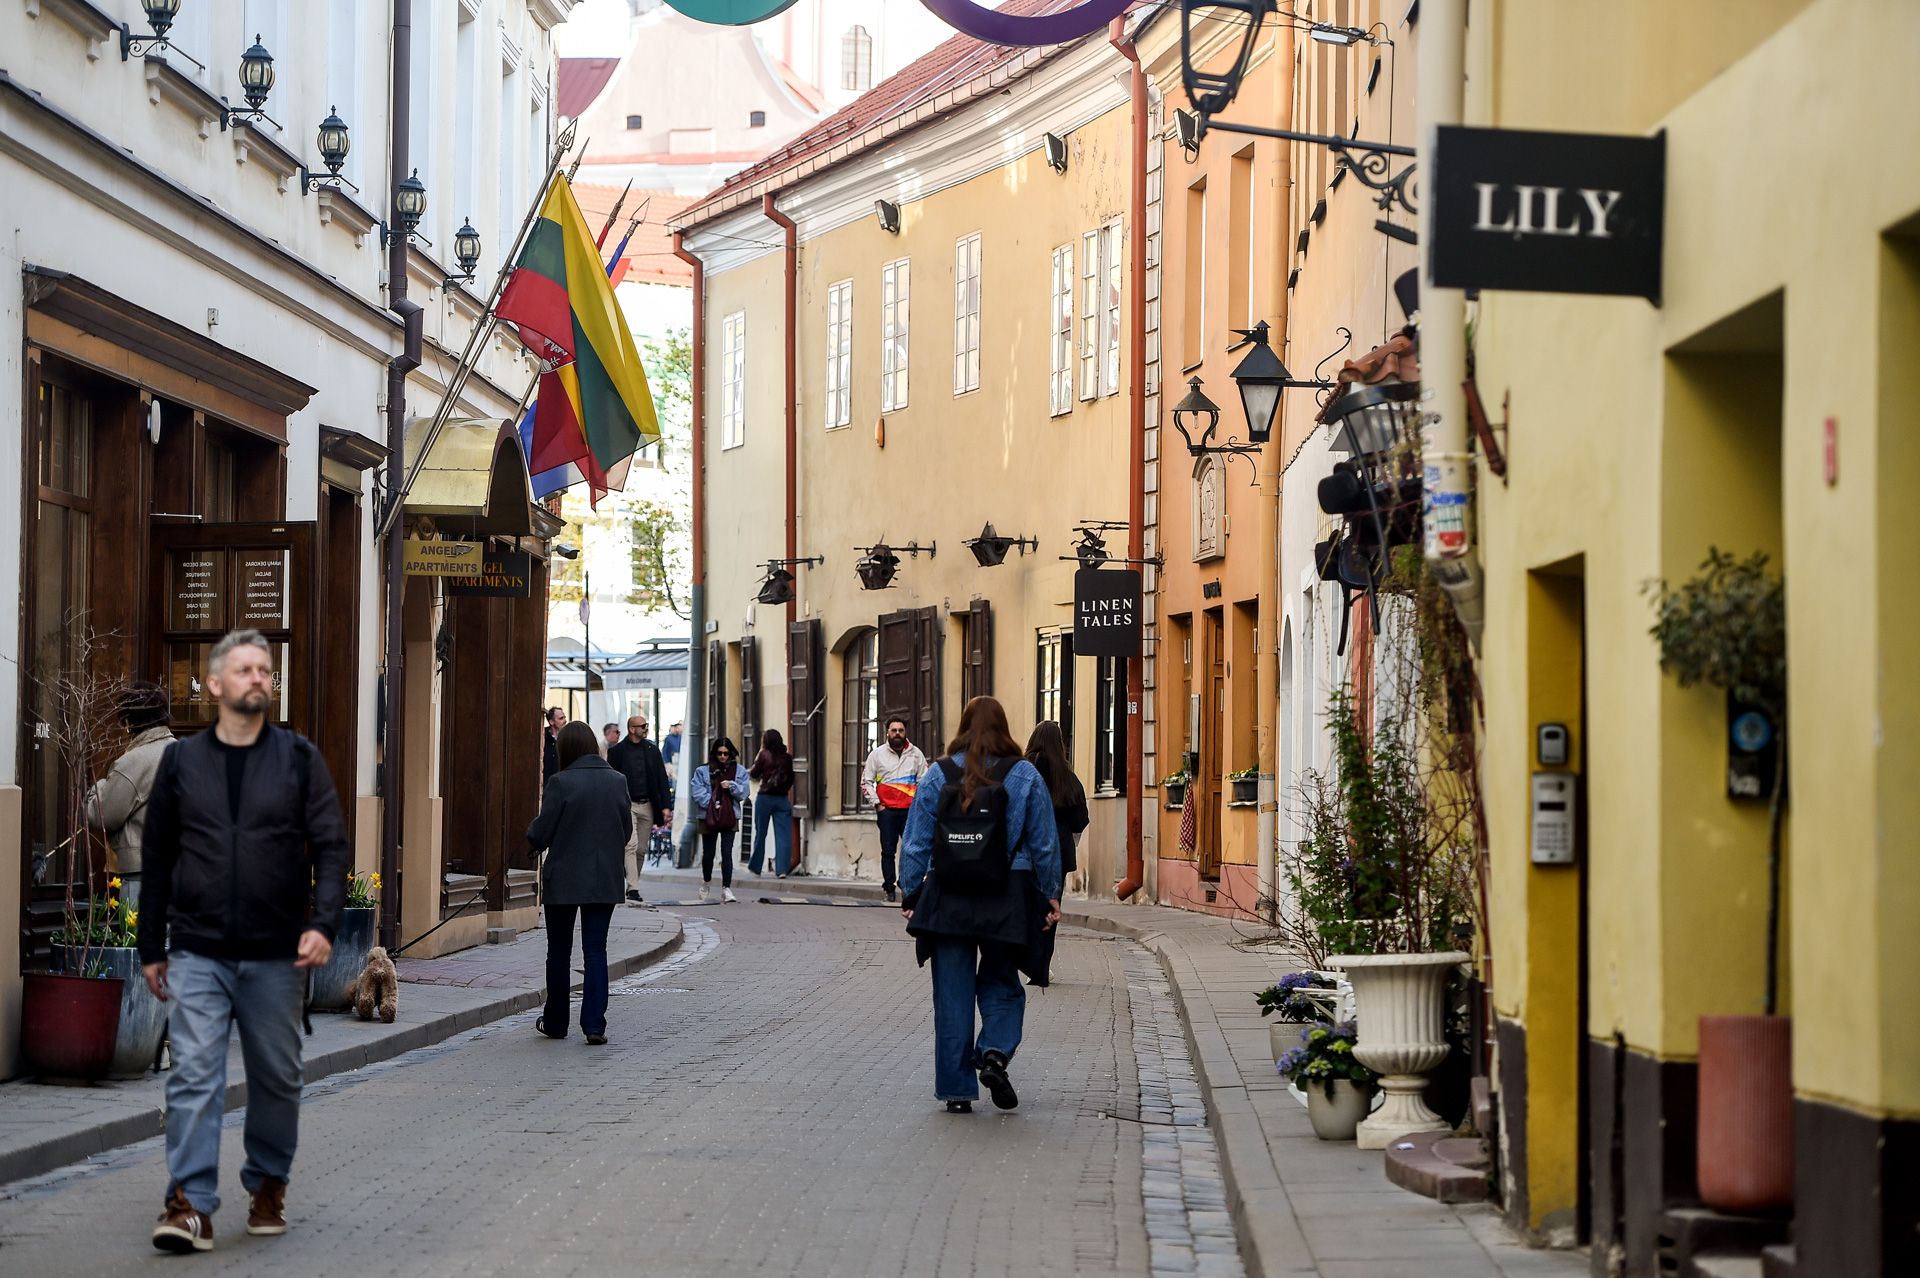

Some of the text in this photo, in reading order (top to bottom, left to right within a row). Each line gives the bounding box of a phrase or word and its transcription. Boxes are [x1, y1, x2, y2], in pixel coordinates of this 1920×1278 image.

[1473, 182, 1622, 238] LILY
[405, 562, 477, 573] APARTMENTS
[483, 560, 505, 574] GEL
[1081, 598, 1133, 612] LINEN
[1081, 613, 1132, 627] TALES
